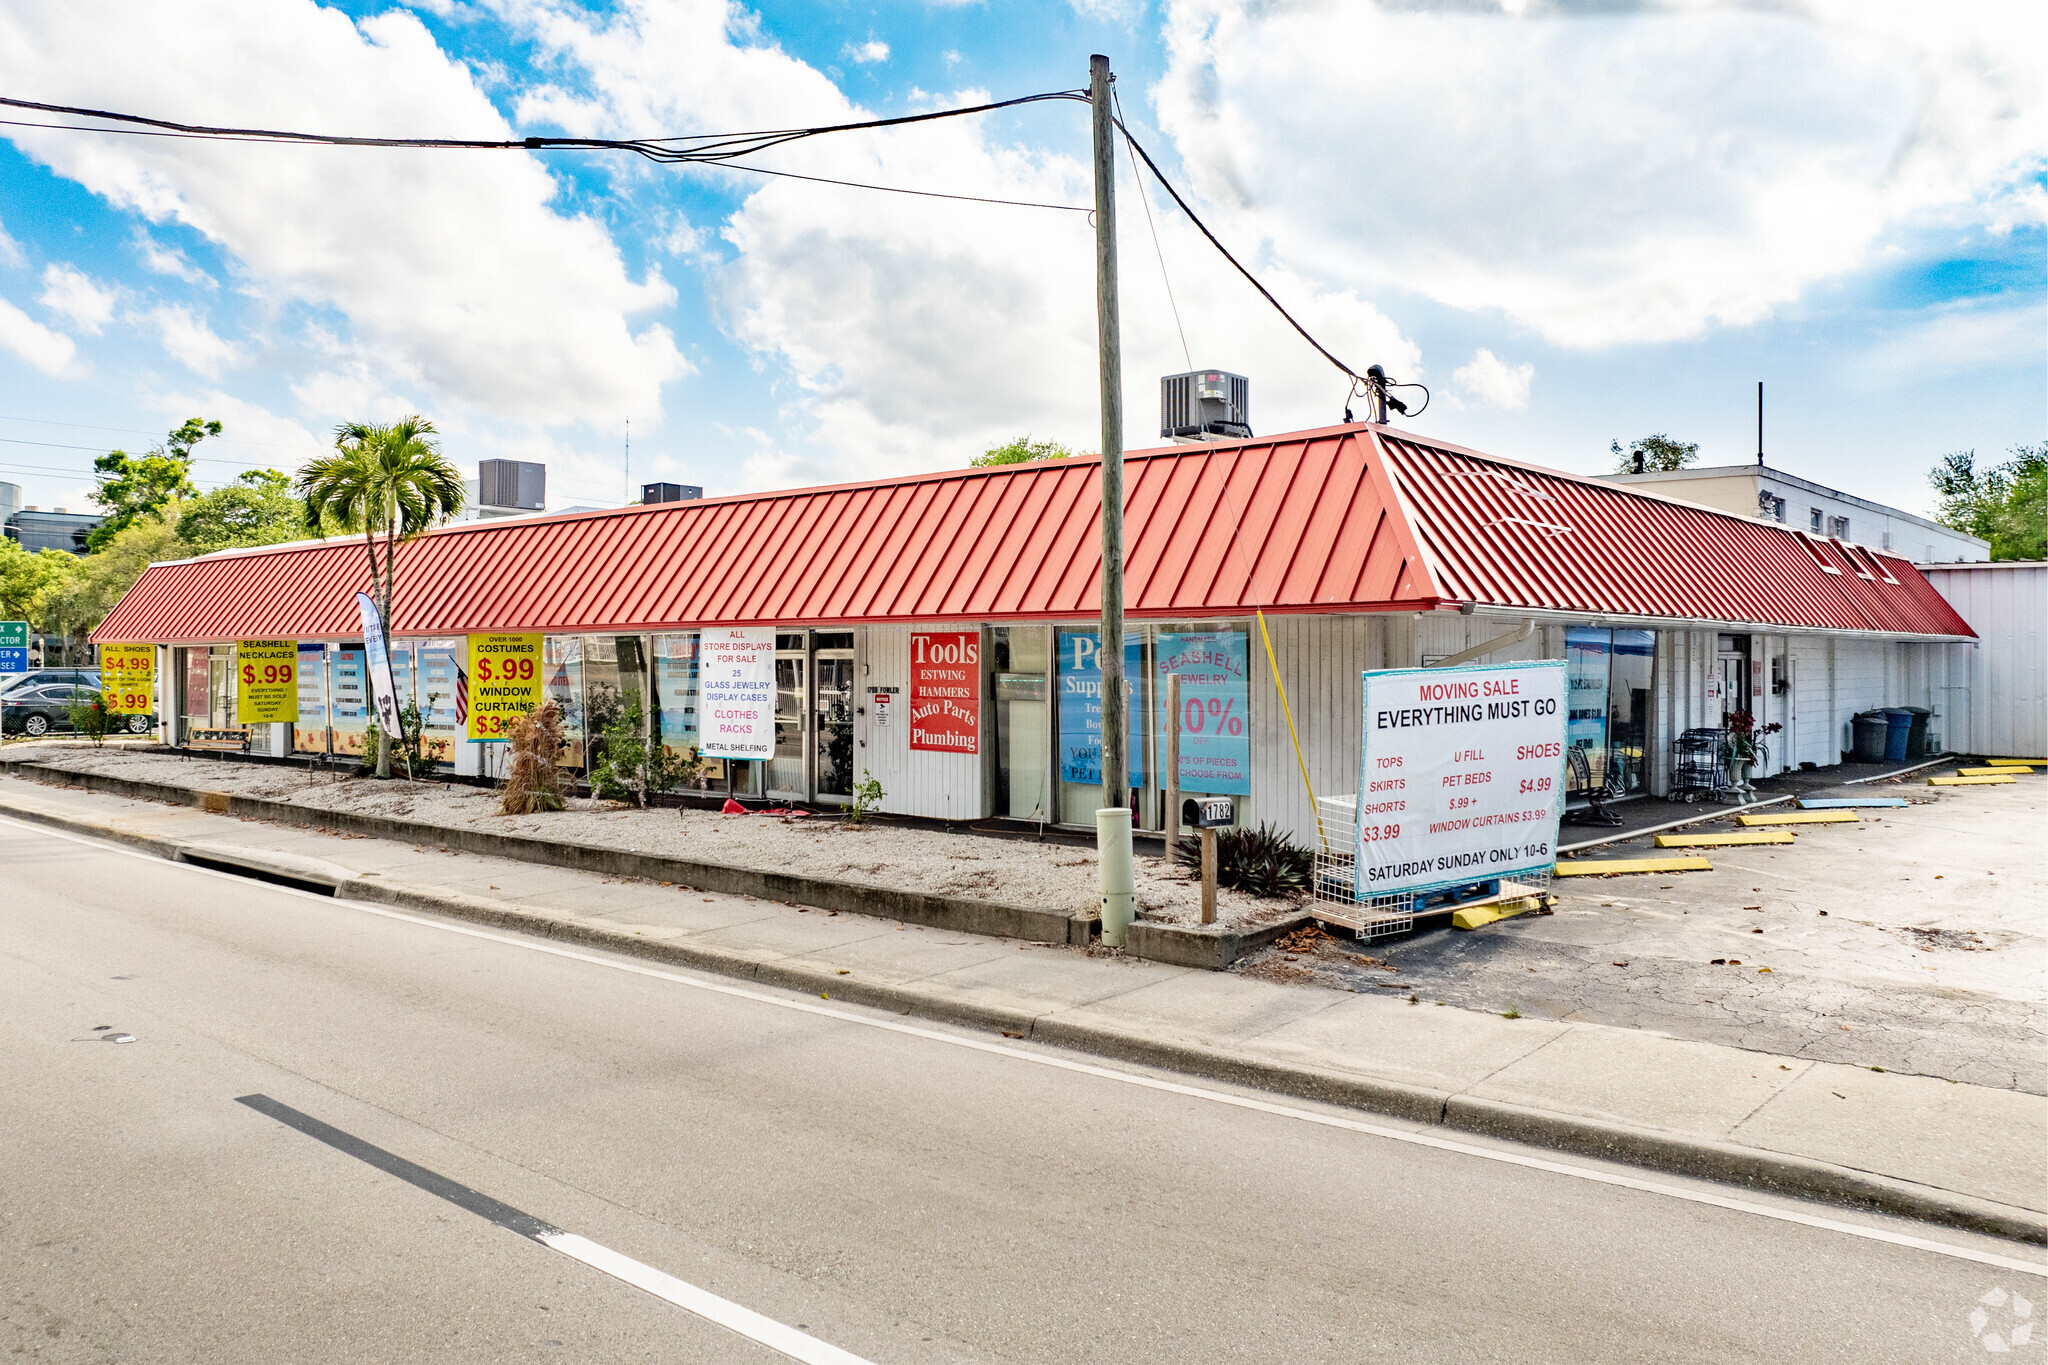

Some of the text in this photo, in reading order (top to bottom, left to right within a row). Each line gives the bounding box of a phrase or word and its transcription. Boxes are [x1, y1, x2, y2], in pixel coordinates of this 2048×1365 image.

[478, 644, 534, 653] COSTUMES
[704, 643, 772, 651] STORE DISPLAYS
[912, 636, 978, 664] Tools
[106, 656, 150, 670] $4.99
[718, 655, 757, 663] FOR SALE
[1160, 651, 1242, 677] SEASHELL
[242, 664, 292, 686] $.99
[478, 657, 534, 682] $.99
[920, 670, 966, 680] ESTWING
[704, 681, 770, 690] GLASS JEWELRY
[1181, 674, 1228, 685] EWELRY
[480, 687, 532, 696] WINDOW
[919, 686, 970, 698] HAMMERS
[1420, 679, 1520, 702] MOVING SALE
[108, 694, 148, 709] $.99
[740, 694, 768, 702] CASES
[714, 710, 758, 720] CLOTHES
[912, 702, 940, 724] Auto
[943, 700, 976, 726] Parts
[1378, 698, 1556, 729] EVERYTHING MUST GO
[720, 724, 752, 734] RACKS
[912, 728, 976, 752] Plumbing
[1194, 737, 1209, 745] OFF
[706, 743, 768, 752] METAL SHELFING
[1516, 742, 1561, 760] SHOES
[1193, 757, 1204, 765] OF
[1206, 758, 1237, 767] PIECES
[1376, 756, 1403, 769] TOPS
[1454, 749, 1485, 763] U FILL
[1071, 767, 1094, 780] PET
[1180, 769, 1242, 780] CHOOSE FROM
[1442, 772, 1492, 788] PET BEDS
[1370, 778, 1406, 793] SKIRTS
[1520, 776, 1552, 795] $4.99
[1364, 800, 1406, 816] SHORTS
[1449, 797, 1469, 810] $.99
[1208, 804, 1230, 819] 1782
[1430, 809, 1547, 834] WINDOW CURTAINS $3.99
[1363, 823, 1400, 844] $3.99
[1368, 843, 1548, 882] SATURDAY SUNDAY ONLY 10-6
